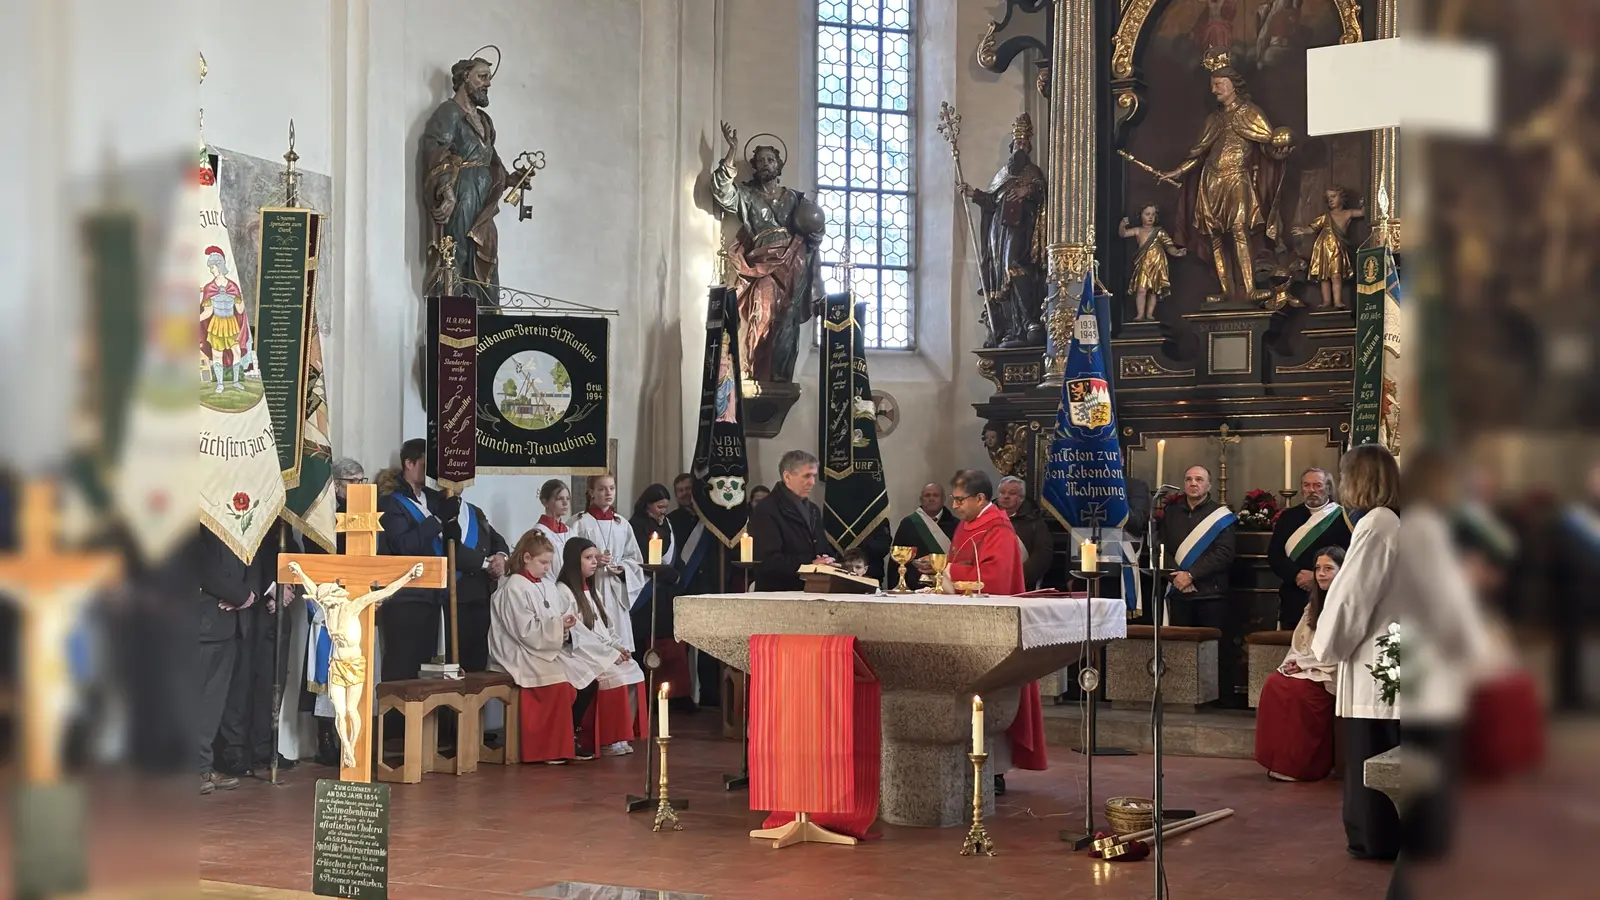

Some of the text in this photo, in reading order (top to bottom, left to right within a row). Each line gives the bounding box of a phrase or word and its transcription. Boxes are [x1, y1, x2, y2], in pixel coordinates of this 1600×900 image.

[476, 323, 548, 356] aibaum-Verein
[1080, 330, 1097, 339] 1945
[586, 392, 602, 400] 1994
[444, 446, 471, 457] Gertrud
[1060, 447, 1094, 462] Toten
[1097, 450, 1118, 461] zur
[447, 458, 468, 467] Bauer
[1066, 463, 1123, 479] Lebenden
[1065, 481, 1125, 500] Mahnung
[347, 785, 371, 793] GEDENKEN
[347, 861, 358, 870] der
[359, 862, 384, 872] Cholera
[339, 885, 360, 896] R.I.P.
